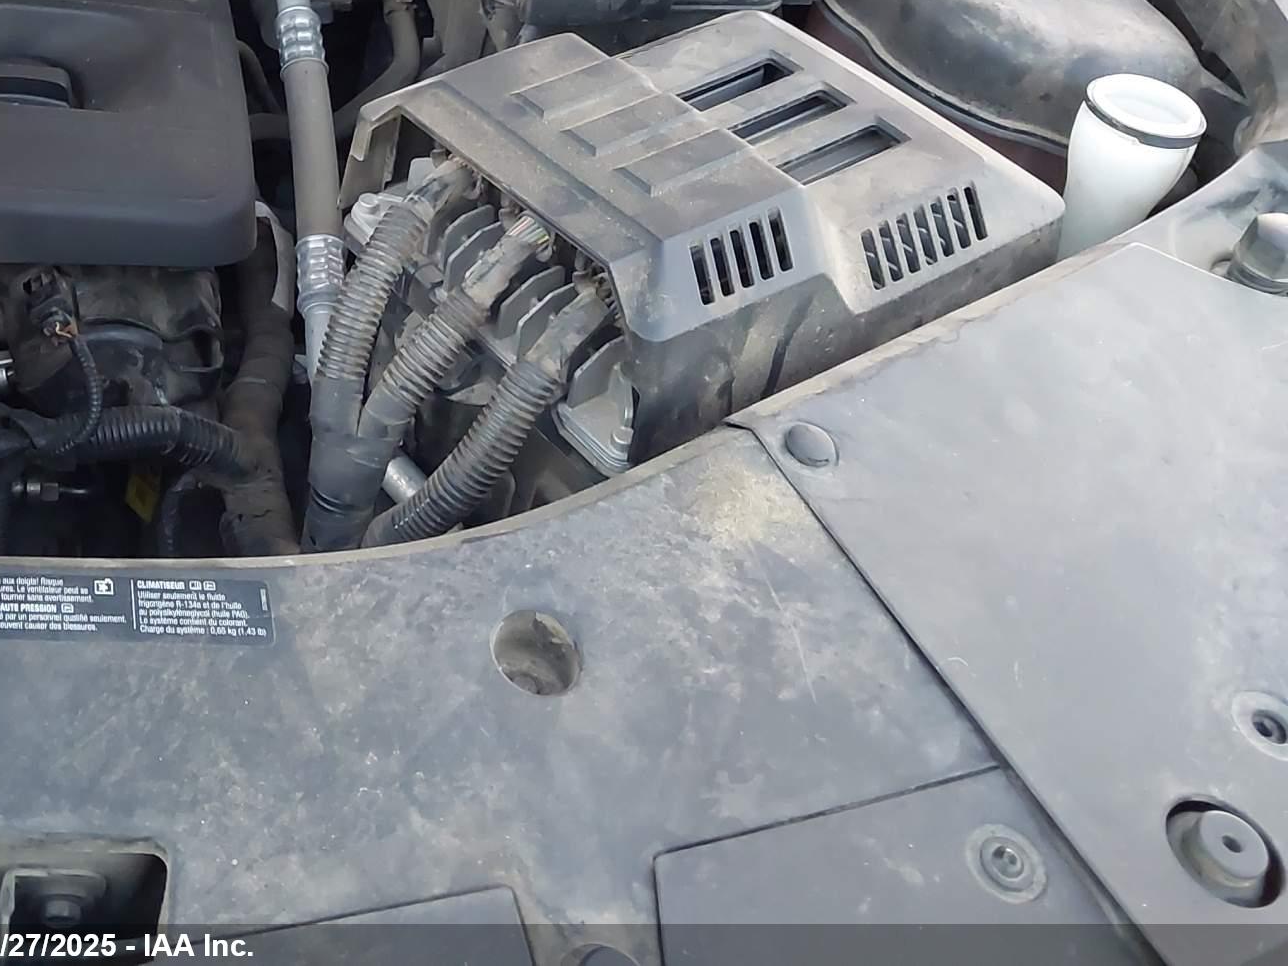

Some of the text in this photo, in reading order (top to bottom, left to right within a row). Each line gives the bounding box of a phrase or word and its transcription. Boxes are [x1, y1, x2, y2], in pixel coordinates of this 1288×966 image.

[136, 580, 185, 590] CLIMATISEUR
[16, 585, 26, 593] Le
[26, 585, 63, 594] ventilateur
[63, 586, 79, 596] peut
[1, 593, 26, 601] tourner
[137, 591, 226, 601] Utiliser seulement le fluide
[20, 603, 57, 613] PRESSION
[202, 601, 210, 609] et
[211, 601, 221, 609] de
[5, 614, 17, 623] par
[28, 613, 62, 624] personnel
[139, 616, 149, 624] Le
[179, 617, 207, 626] contient
[208, 618, 218, 626] du
[49, 622, 62, 630] des
[140, 625, 165, 636] Charge
[165, 625, 175, 634] du
[228, 626, 237, 637] kg
